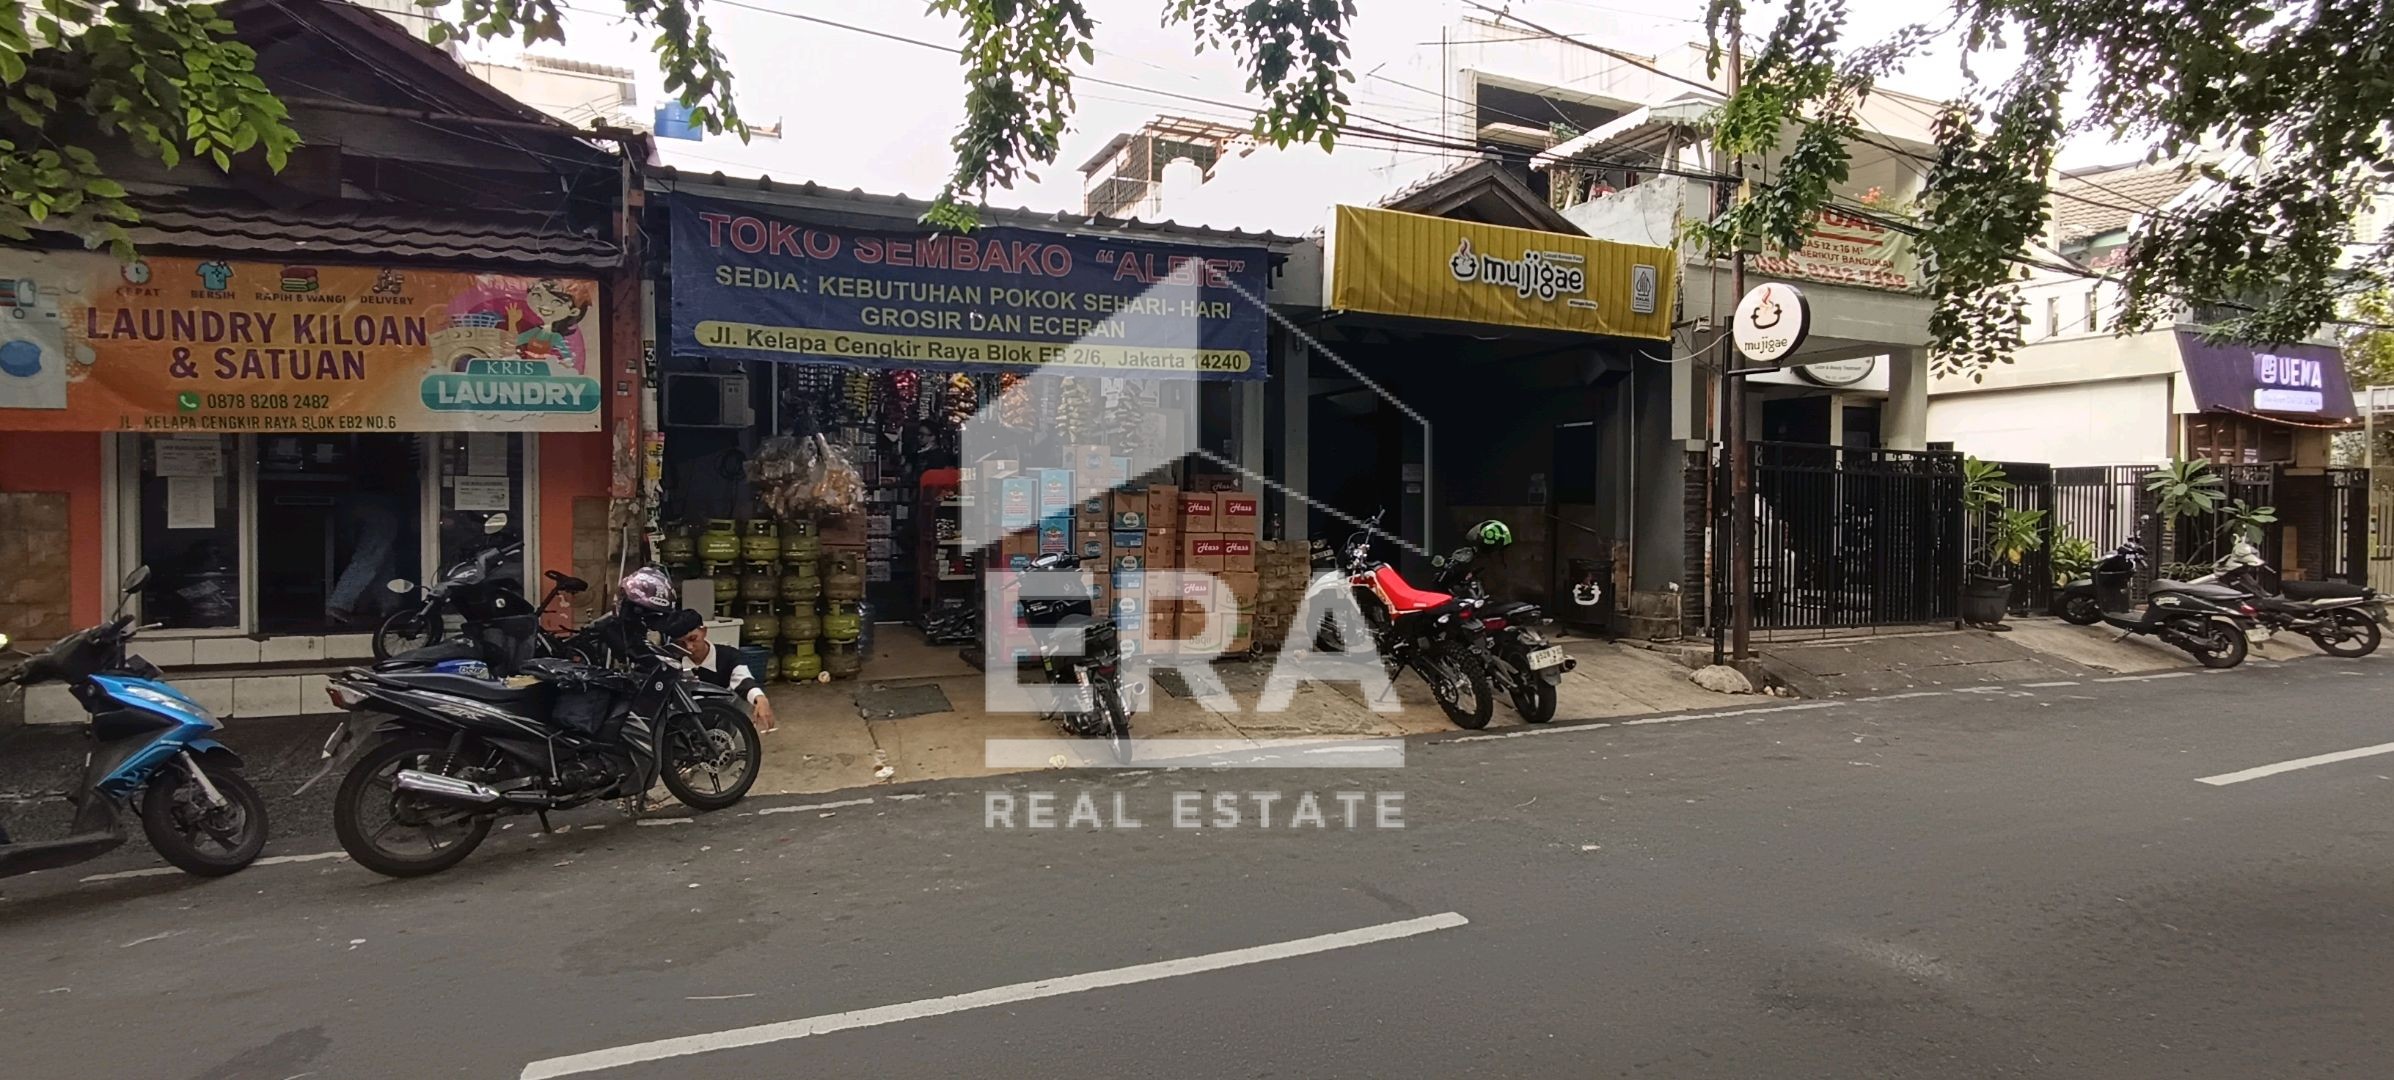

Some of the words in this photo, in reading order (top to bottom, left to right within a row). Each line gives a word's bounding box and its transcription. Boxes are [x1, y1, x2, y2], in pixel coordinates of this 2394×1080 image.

[699, 212, 841, 260] TOKO
[853, 235, 1073, 277] SEMBAKO
[1800, 250, 1840, 262] BERIKUT
[1483, 251, 1583, 298] mujigae
[190, 289, 236, 299] BERSIH
[255, 292, 293, 302] RAPIH
[360, 295, 415, 305] DELIVERY
[715, 265, 808, 293] SEDIA:
[818, 275, 981, 304] KEBUTUHAN
[990, 286, 1077, 310] POKOK
[1180, 299, 1231, 319] HARI
[87, 306, 277, 344] LAUNDRY
[293, 313, 427, 347] KILOAN
[861, 306, 961, 331] GROSIR
[969, 311, 1022, 334] DAN
[1029, 316, 1126, 339] ECERAN
[747, 328, 827, 352] Kelapa
[834, 336, 921, 358] Cengkir
[928, 341, 980, 363] Raya
[988, 344, 1032, 363] Blok
[1039, 347, 1066, 363] EB
[1118, 350, 1185, 369] Jakarta
[1191, 353, 1242, 371] 14240
[1744, 336, 1788, 354] mujigae
[168, 347, 199, 379] &
[214, 347, 366, 381] SATUAN
[487, 361, 534, 375] KRIS
[207, 393, 246, 409] 0878
[250, 393, 289, 409] 8208
[293, 394, 329, 409] 2482
[438, 380, 586, 406] LAUNDRY
[144, 415, 198, 429] KELAPA
[201, 415, 260, 429] CENGKIR
[265, 415, 297, 429] RAYA
[303, 415, 335, 430] BLOK
[340, 416, 362, 429] EB2
